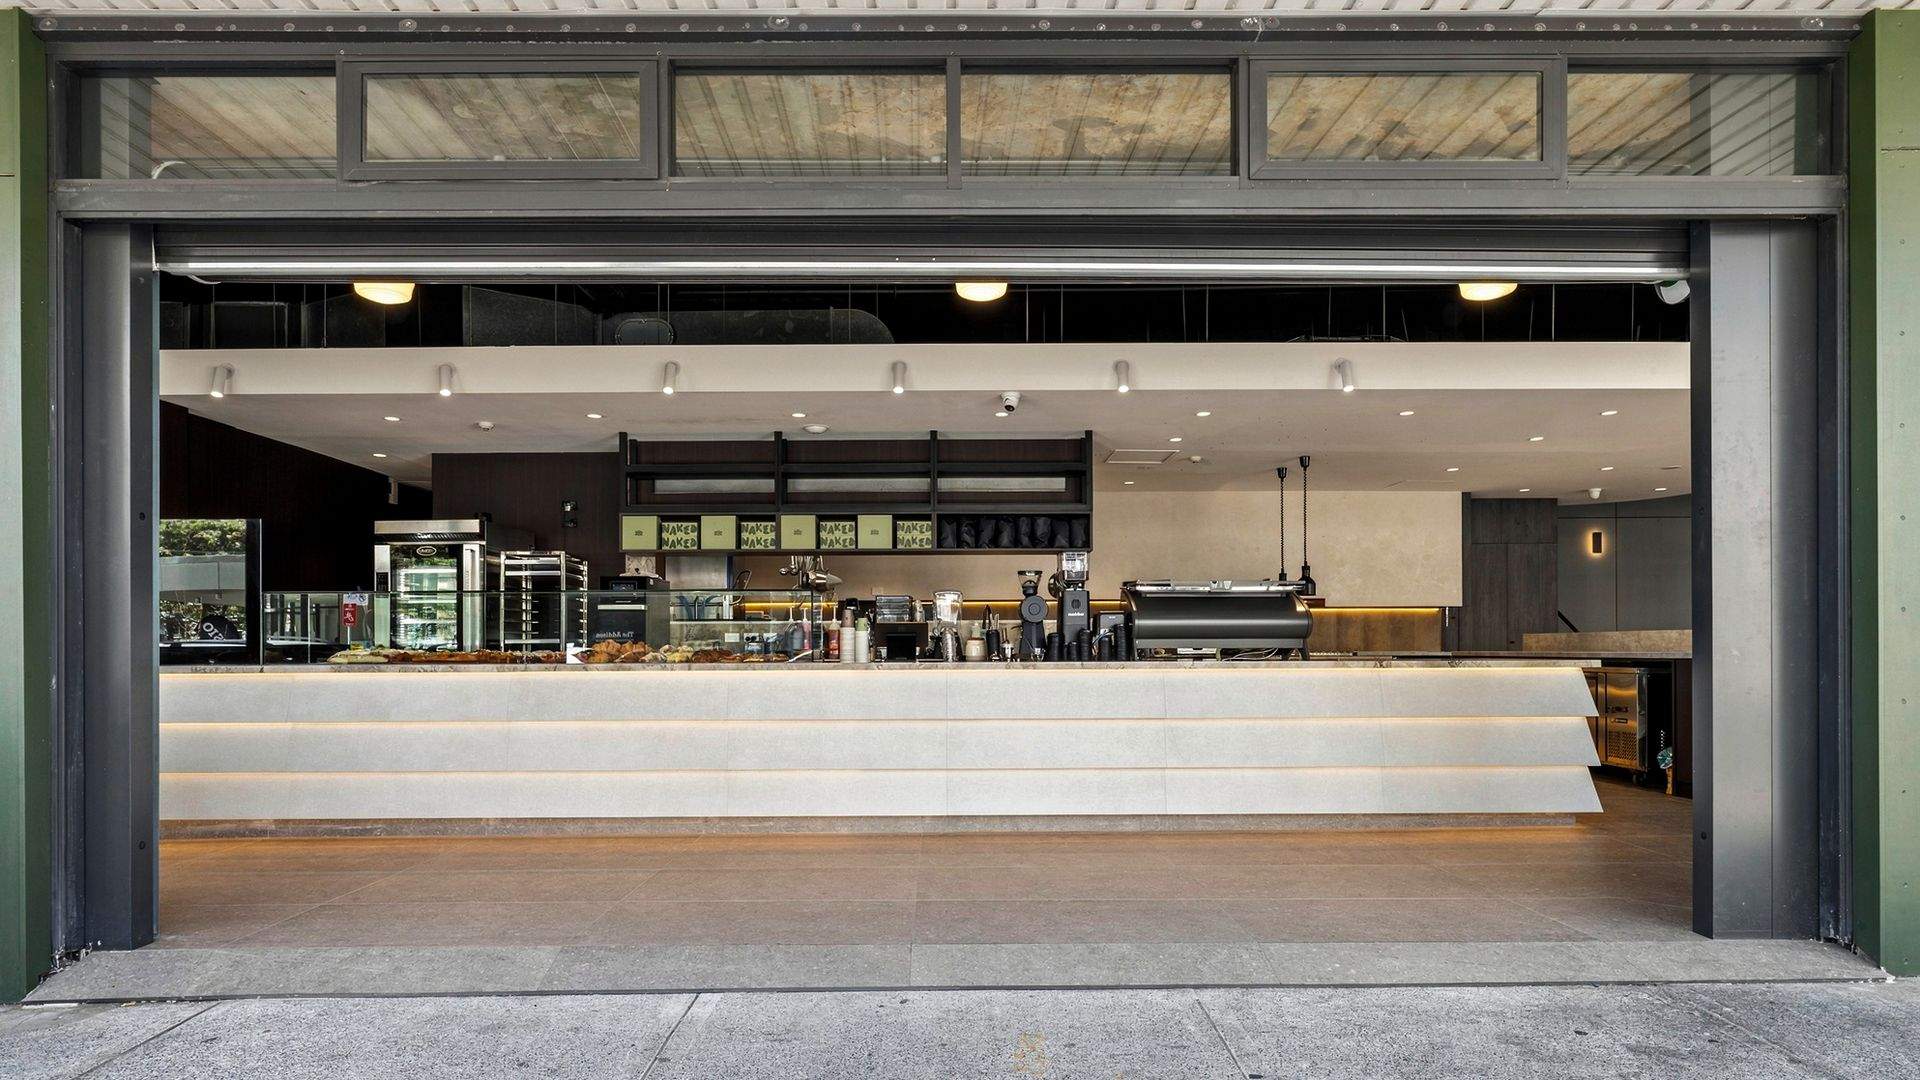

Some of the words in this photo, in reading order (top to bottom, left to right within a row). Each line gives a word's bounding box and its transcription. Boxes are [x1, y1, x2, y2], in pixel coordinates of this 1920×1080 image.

[662, 523, 697, 535] NAKED
[741, 523, 776, 535] NAKED
[820, 523, 855, 535] NAKED
[897, 522, 931, 534] NAKED
[662, 537, 697, 548] NAKED
[741, 536, 776, 548] NAKED
[820, 536, 855, 548] NAKED
[897, 536, 931, 547] NAKED
